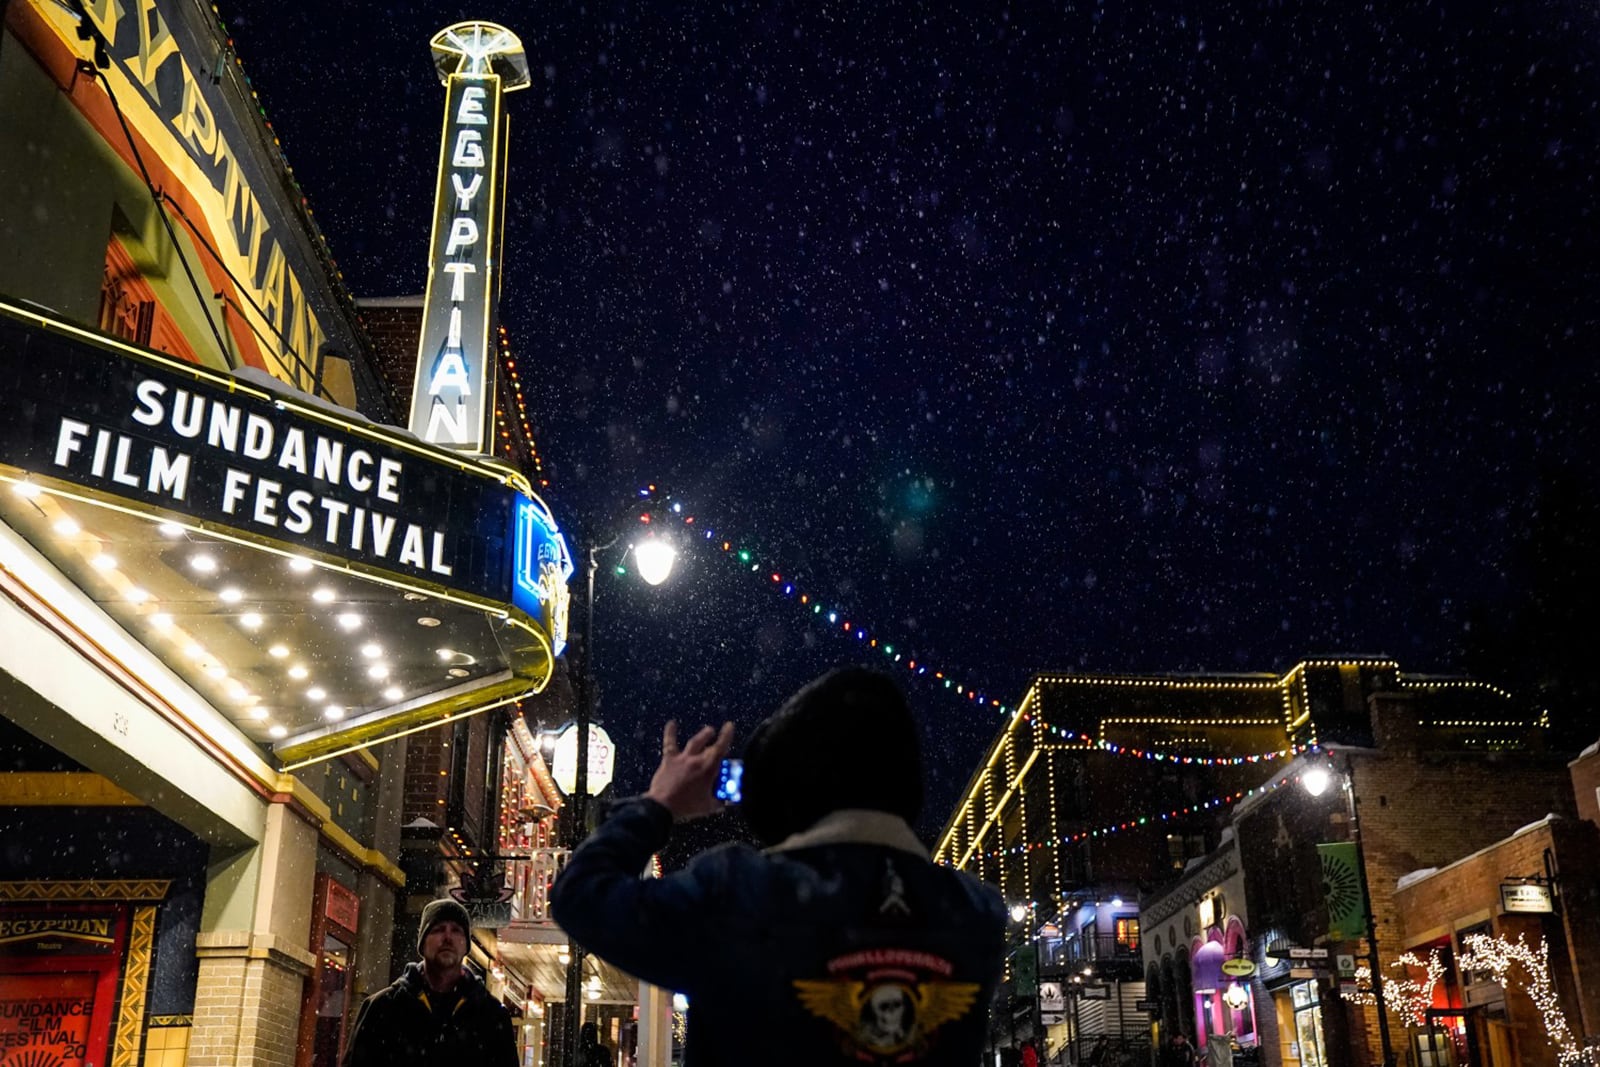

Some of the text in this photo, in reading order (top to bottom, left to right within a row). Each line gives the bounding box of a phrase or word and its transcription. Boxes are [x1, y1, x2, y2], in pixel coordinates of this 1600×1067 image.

[424, 87, 488, 443] EGYPTIAN
[132, 379, 402, 503] SUNDANCE
[54, 417, 453, 576] FILM FESTIVAL
[0, 919, 110, 936] EGYPTIAN
[18, 1017, 62, 1032] FILM
[63, 1045, 87, 1060] 20
